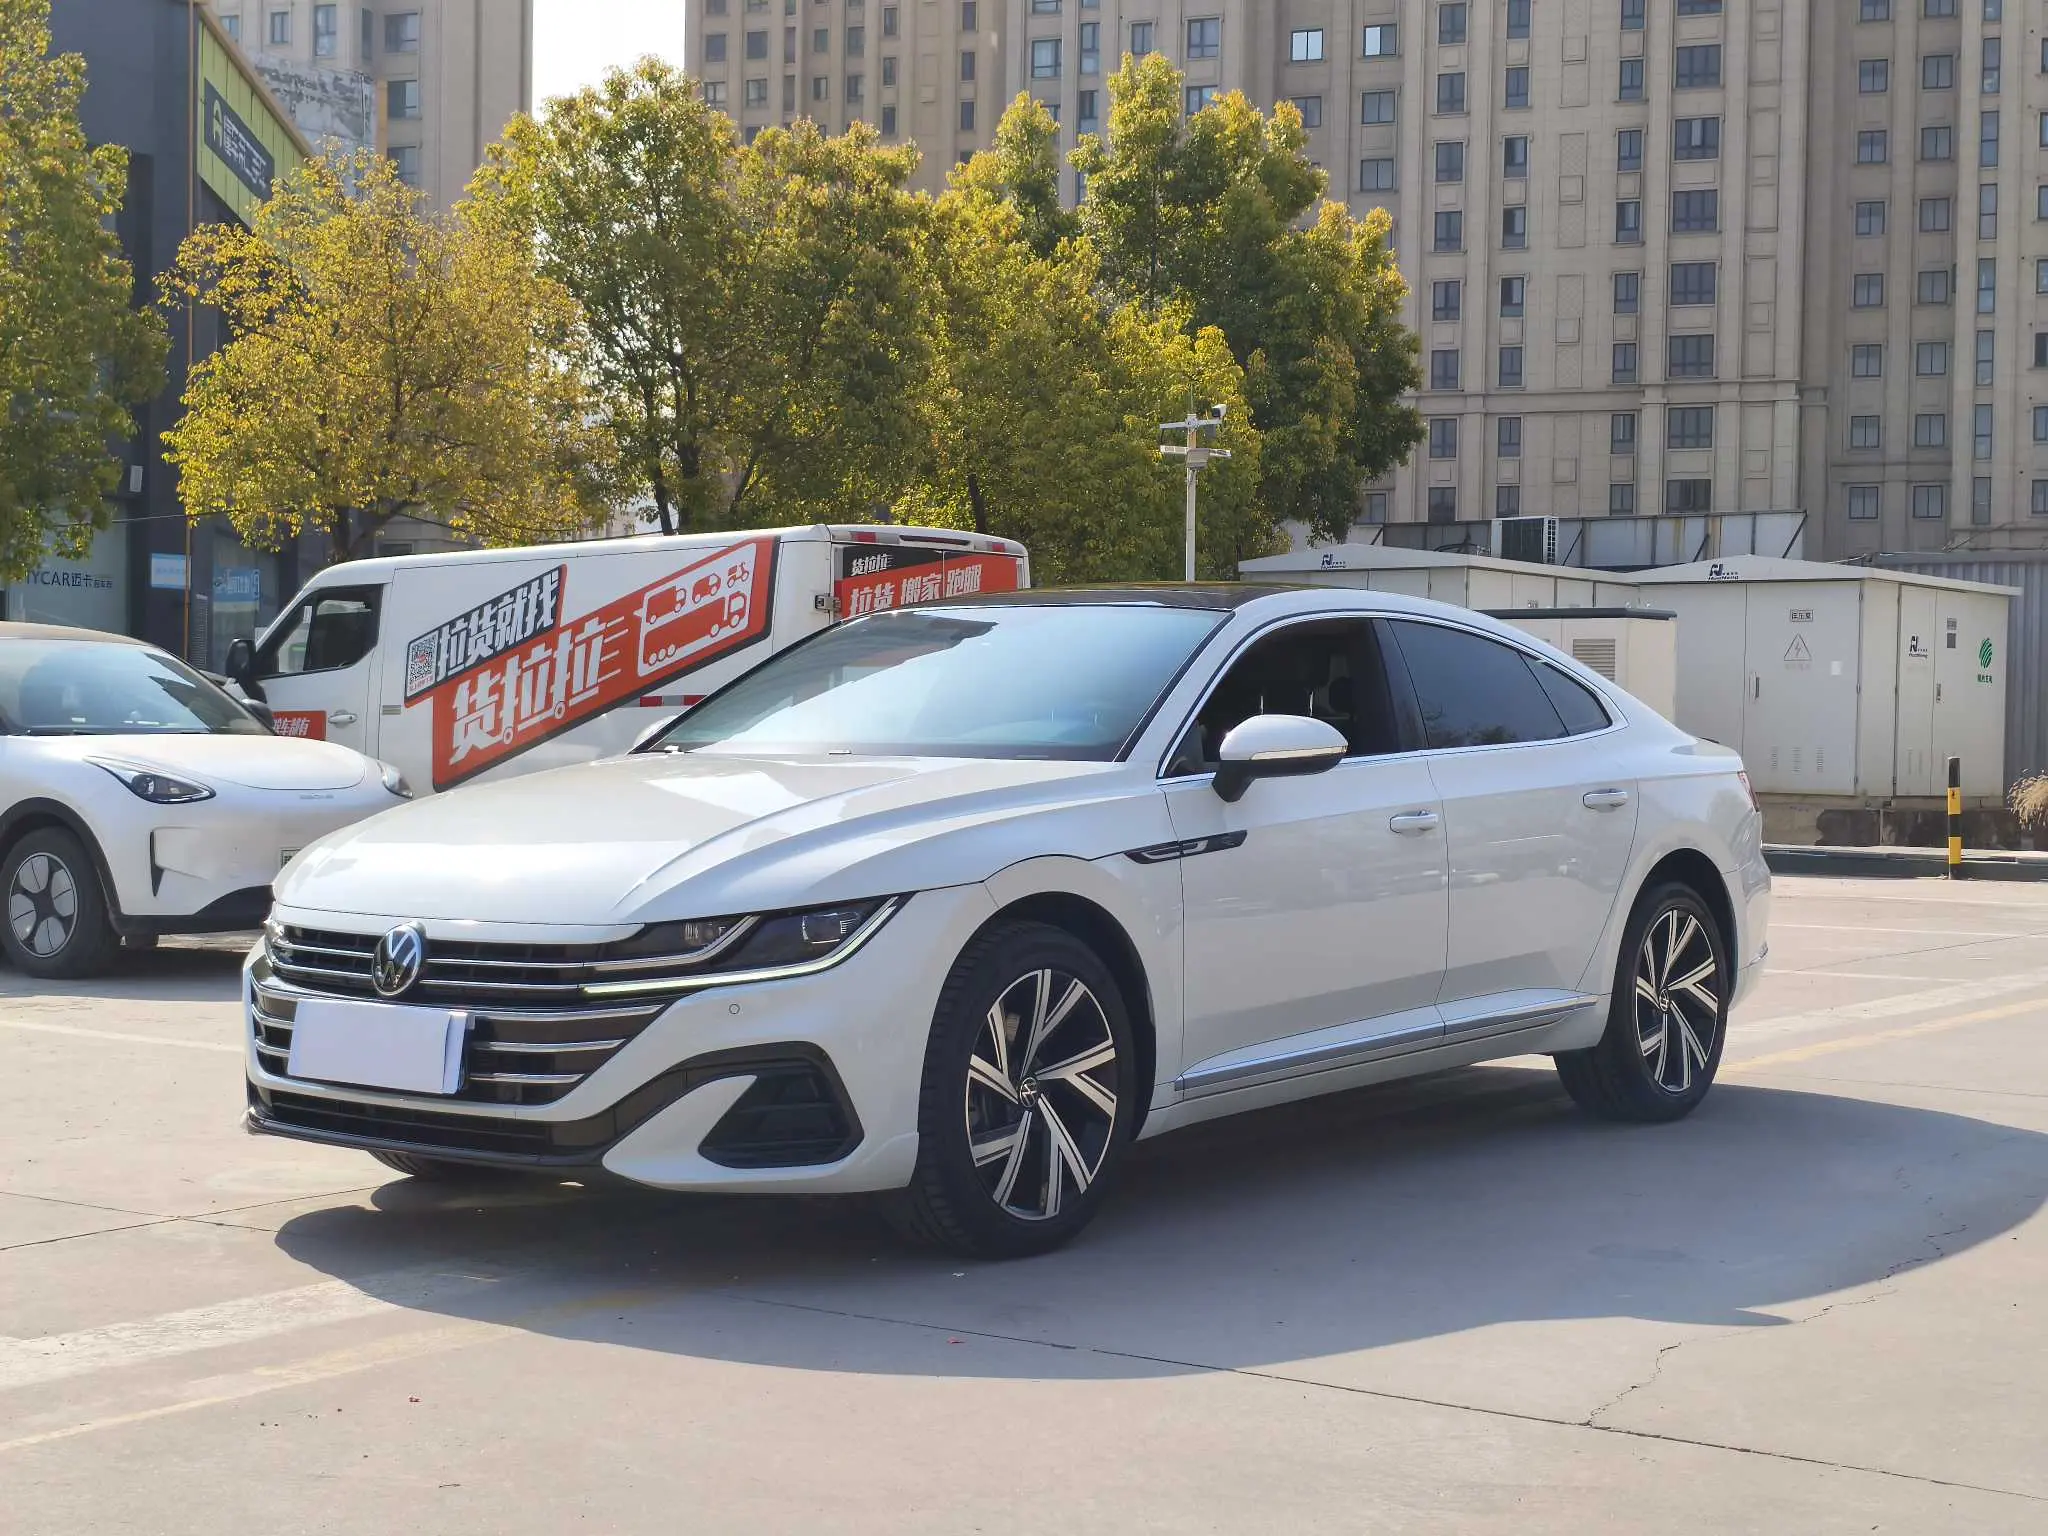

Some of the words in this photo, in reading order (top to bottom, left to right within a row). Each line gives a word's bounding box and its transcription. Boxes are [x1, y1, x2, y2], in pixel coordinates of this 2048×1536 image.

[849, 582, 895, 616] 拉货
[900, 572, 942, 605] 搬家
[946, 563, 982, 597] 跑腿
[851, 553, 889, 576] 货拉拉
[438, 569, 560, 681] 拉货就找
[449, 618, 609, 765] 货拉拉
